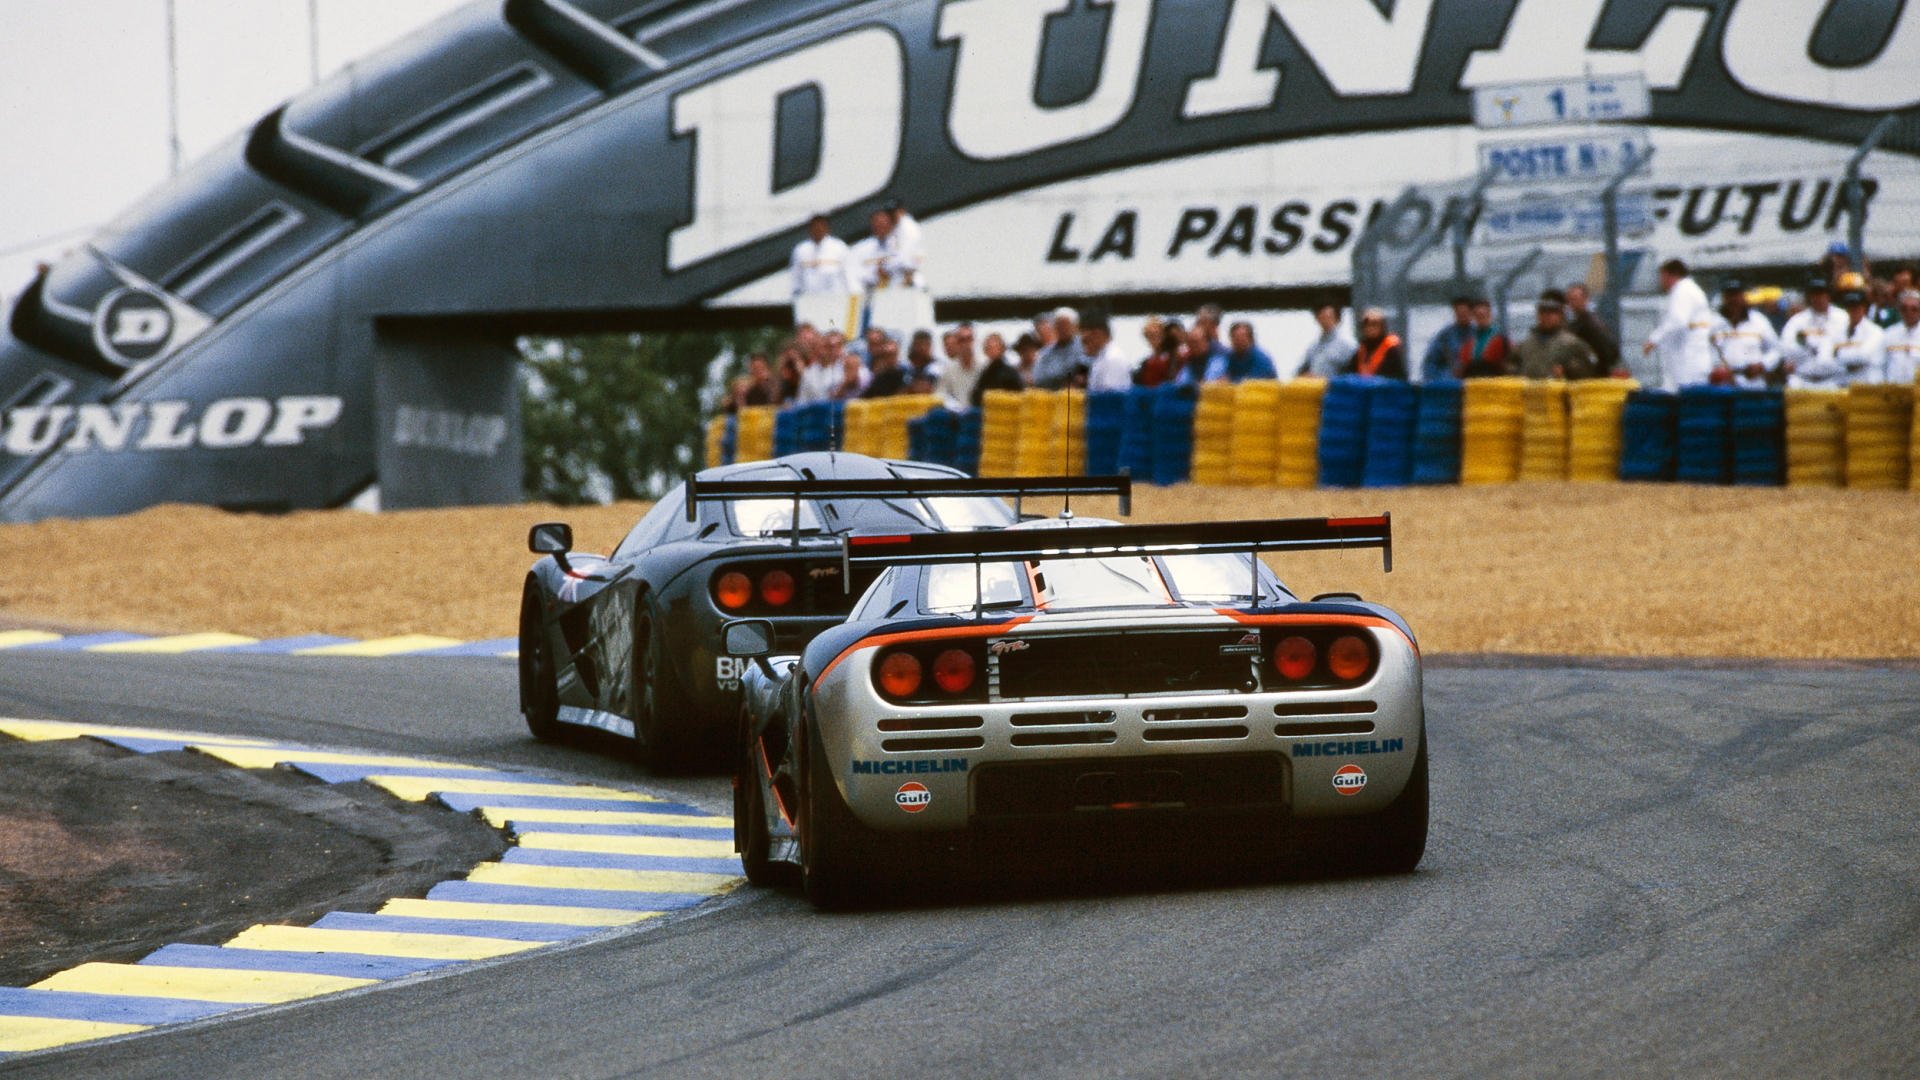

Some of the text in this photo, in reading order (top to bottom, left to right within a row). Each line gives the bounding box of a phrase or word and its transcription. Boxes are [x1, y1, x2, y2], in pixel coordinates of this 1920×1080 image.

[1045, 208, 1138, 262] LA
[112, 309, 169, 343] D
[0, 396, 343, 455] UNLOP
[717, 656, 756, 679] BM
[1292, 738, 1403, 757] MICHELIN
[852, 759, 968, 774] MICHELIN
[1333, 775, 1366, 786] Gulf
[896, 792, 929, 803] Gulf
